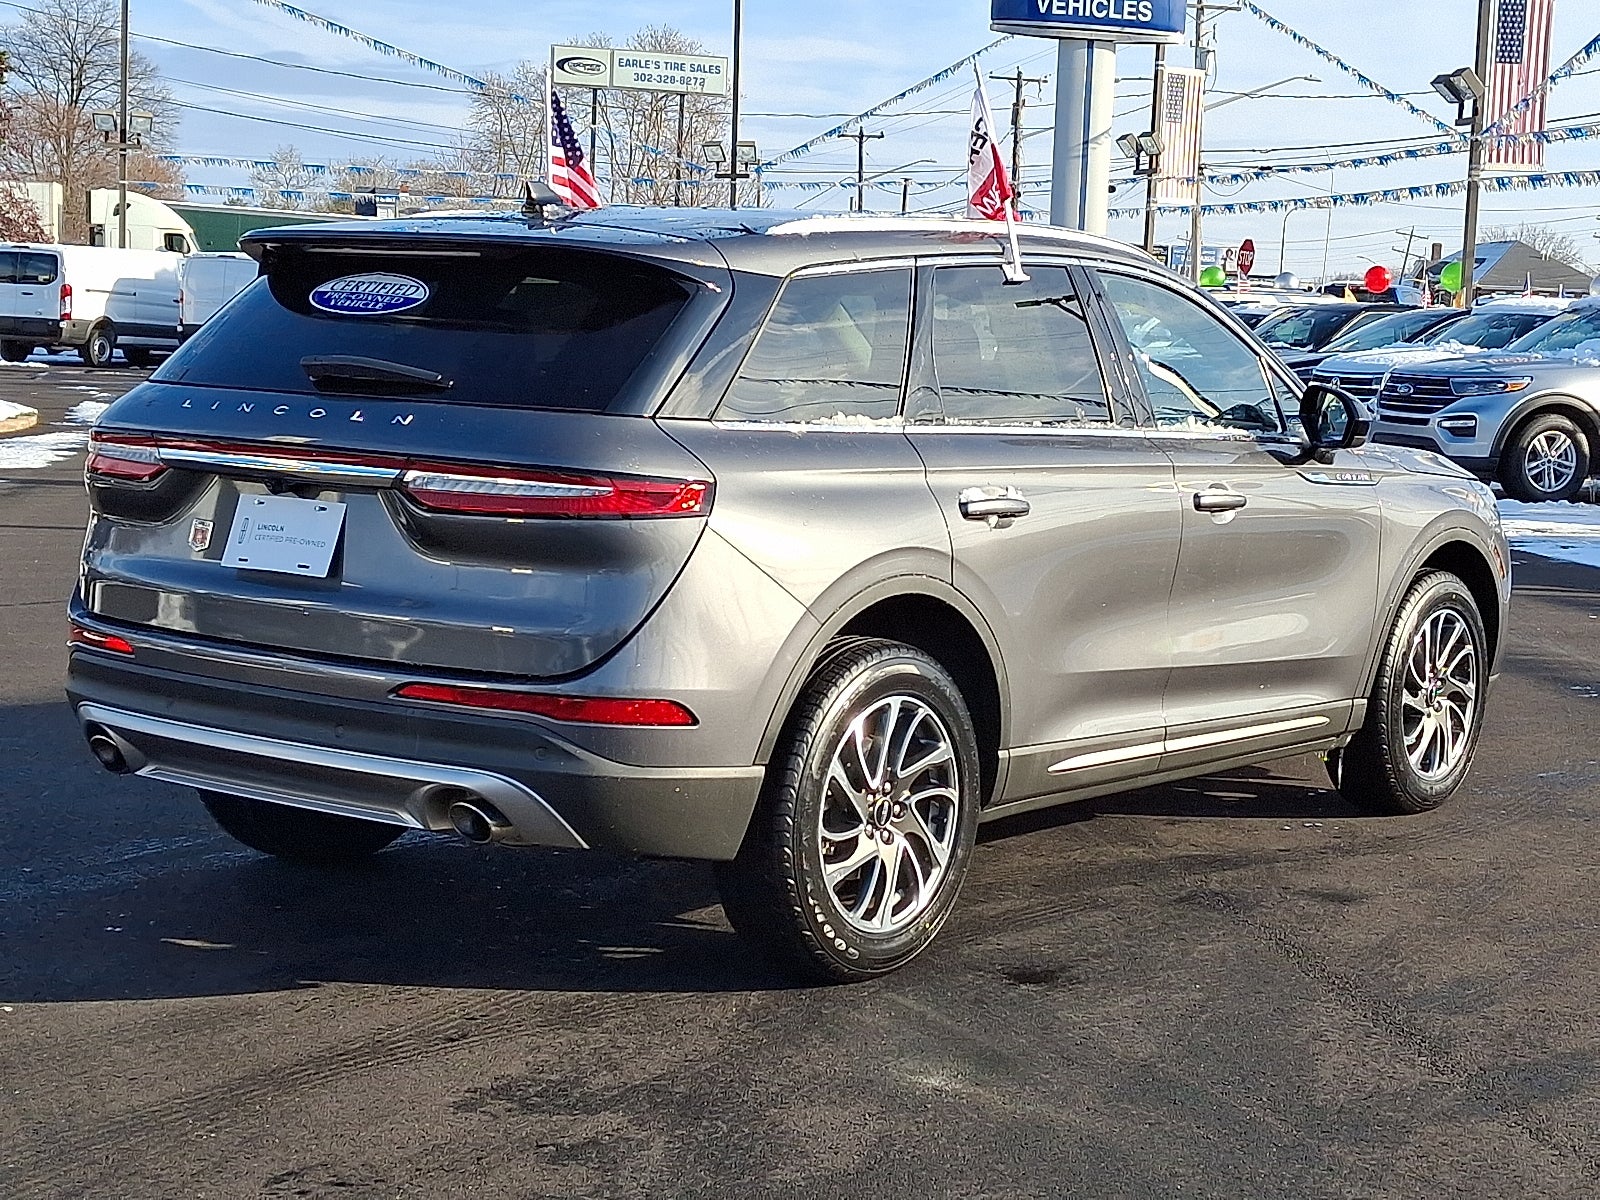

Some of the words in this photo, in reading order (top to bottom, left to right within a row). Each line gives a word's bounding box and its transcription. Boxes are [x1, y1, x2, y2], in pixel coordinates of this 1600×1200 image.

[1037, 0, 1153, 22] VEHICLES
[618, 57, 661, 70] EARLE'S
[664, 61, 687, 72] TIRE
[689, 63, 721, 75] SALES
[633, 72, 706, 87] 302-328-8272
[1239, 250, 1254, 266] STOP
[330, 280, 420, 297] CERTIFIED
[323, 291, 404, 304] PRE-OWNED
[330, 299, 387, 310] VEHICLE
[182, 399, 414, 426] LINCOLN
[257, 523, 285, 532] LINCOLN
[285, 536, 326, 548] PRE-OWNED
